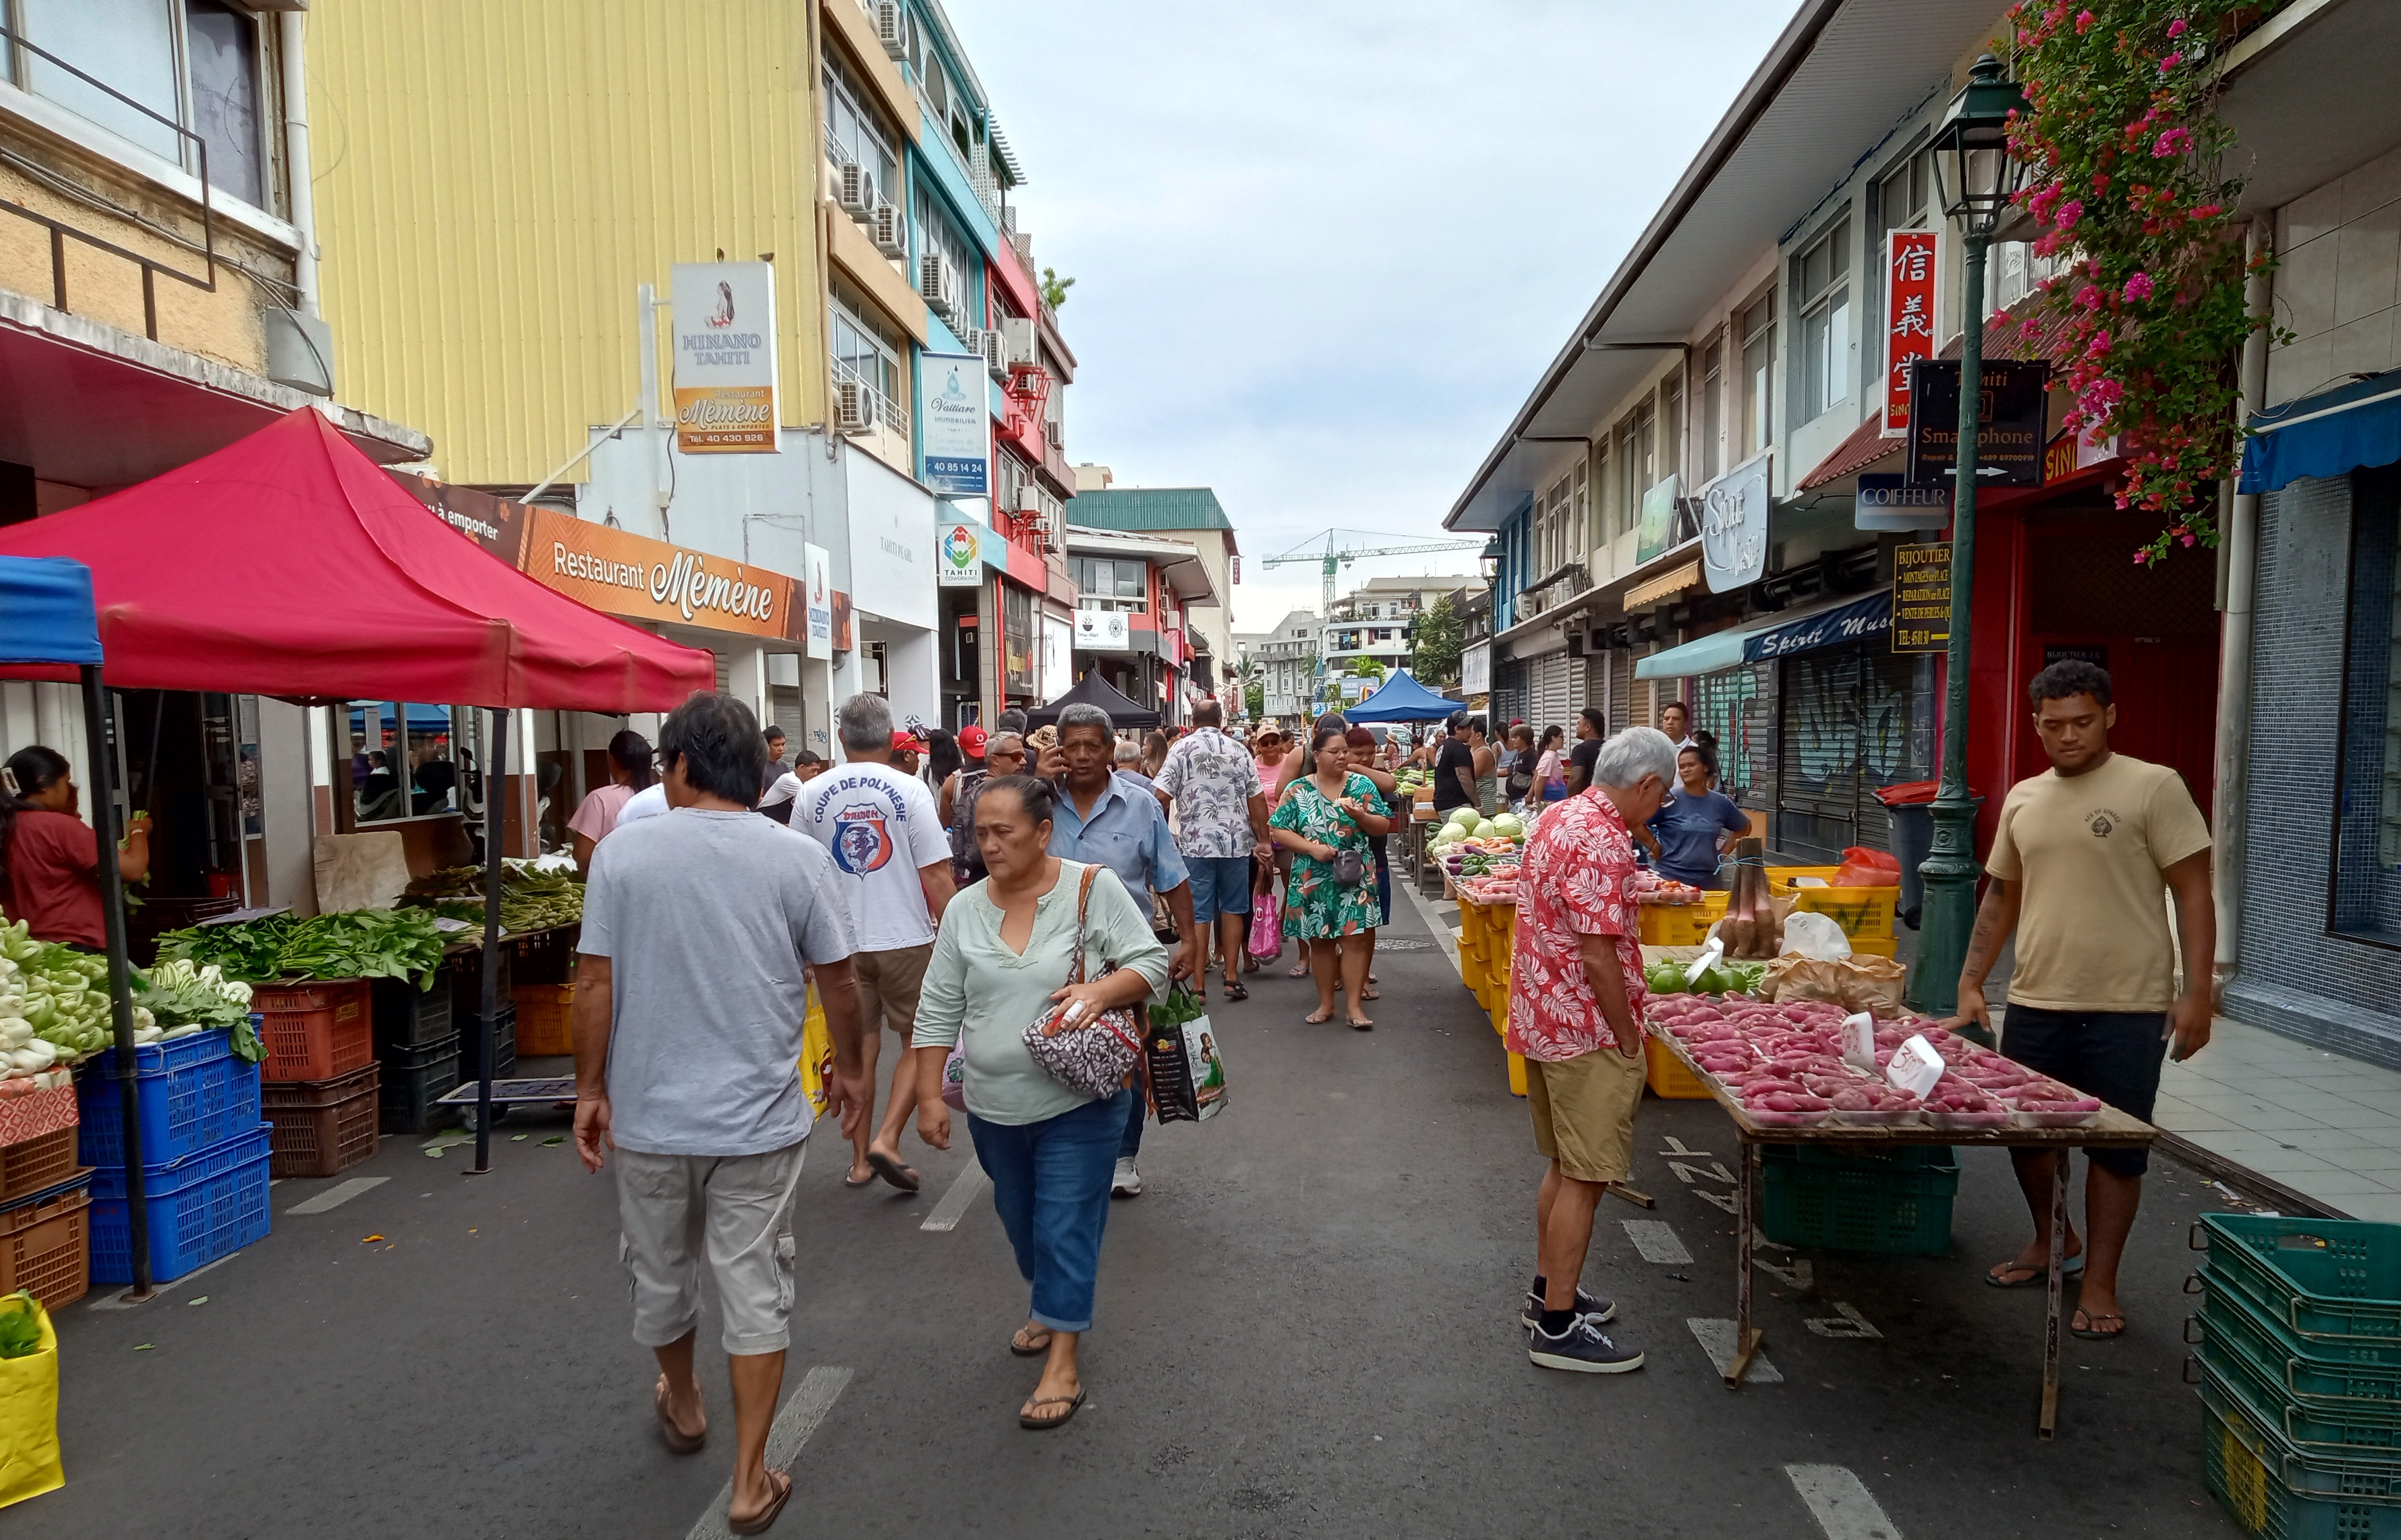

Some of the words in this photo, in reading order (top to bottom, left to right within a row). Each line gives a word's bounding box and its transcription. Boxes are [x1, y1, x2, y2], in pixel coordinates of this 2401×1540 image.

[683, 334, 761, 351] HINANO
[694, 351, 750, 365] TAHITI
[1954, 371, 2008, 387] Thiti
[715, 389, 765, 399] Restaurant
[679, 399, 771, 430] Mèmène
[1921, 427, 2033, 447] Smaphone
[934, 462, 945, 472] 40
[947, 462, 958, 472] 85
[960, 463, 969, 473] 14
[972, 464, 982, 473] 24
[1862, 488, 1945, 505] COIFFEUR
[448, 510, 499, 540] emporter
[1899, 548, 1950, 567] BIJOUTIER
[554, 541, 645, 590] Restaurant
[650, 551, 774, 621] Mèmène
[1903, 571, 1928, 583] MONTAGES
[1934, 569, 1948, 582] PLACE
[1936, 588, 1950, 600] PLACE
[1902, 607, 1917, 619] VENTE
[1918, 607, 1925, 619] DE
[1762, 624, 1823, 655] Spirit
[815, 784, 839, 824] COUPE
[839, 777, 857, 791] DE
[860, 777, 907, 822] POLYNESIE
